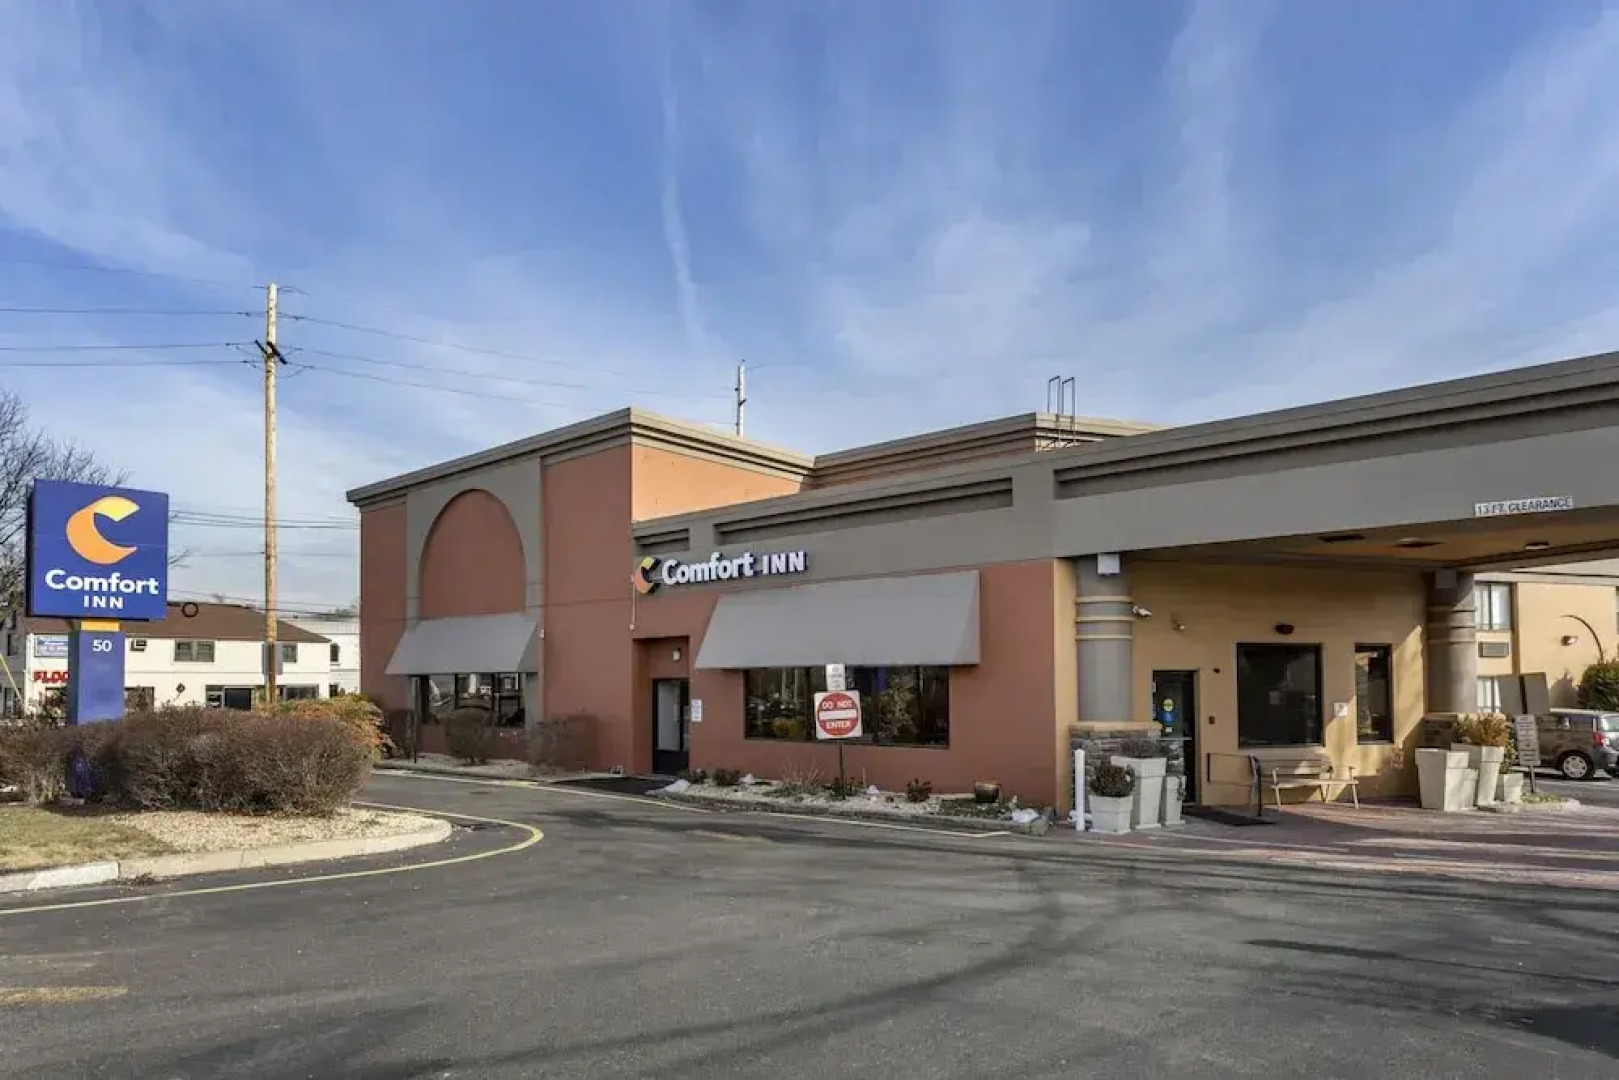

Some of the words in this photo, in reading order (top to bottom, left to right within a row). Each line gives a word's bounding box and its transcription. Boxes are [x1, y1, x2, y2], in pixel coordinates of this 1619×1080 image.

[1508, 497, 1571, 512] CLEARANCE
[661, 551, 755, 585] Comfort
[762, 550, 805, 574] INN
[45, 569, 159, 594] Comfort
[83, 595, 124, 609] INN
[92, 639, 112, 652] 50
[822, 700, 833, 709] DO
[837, 699, 853, 708] NOT
[826, 720, 851, 730] ENTER
